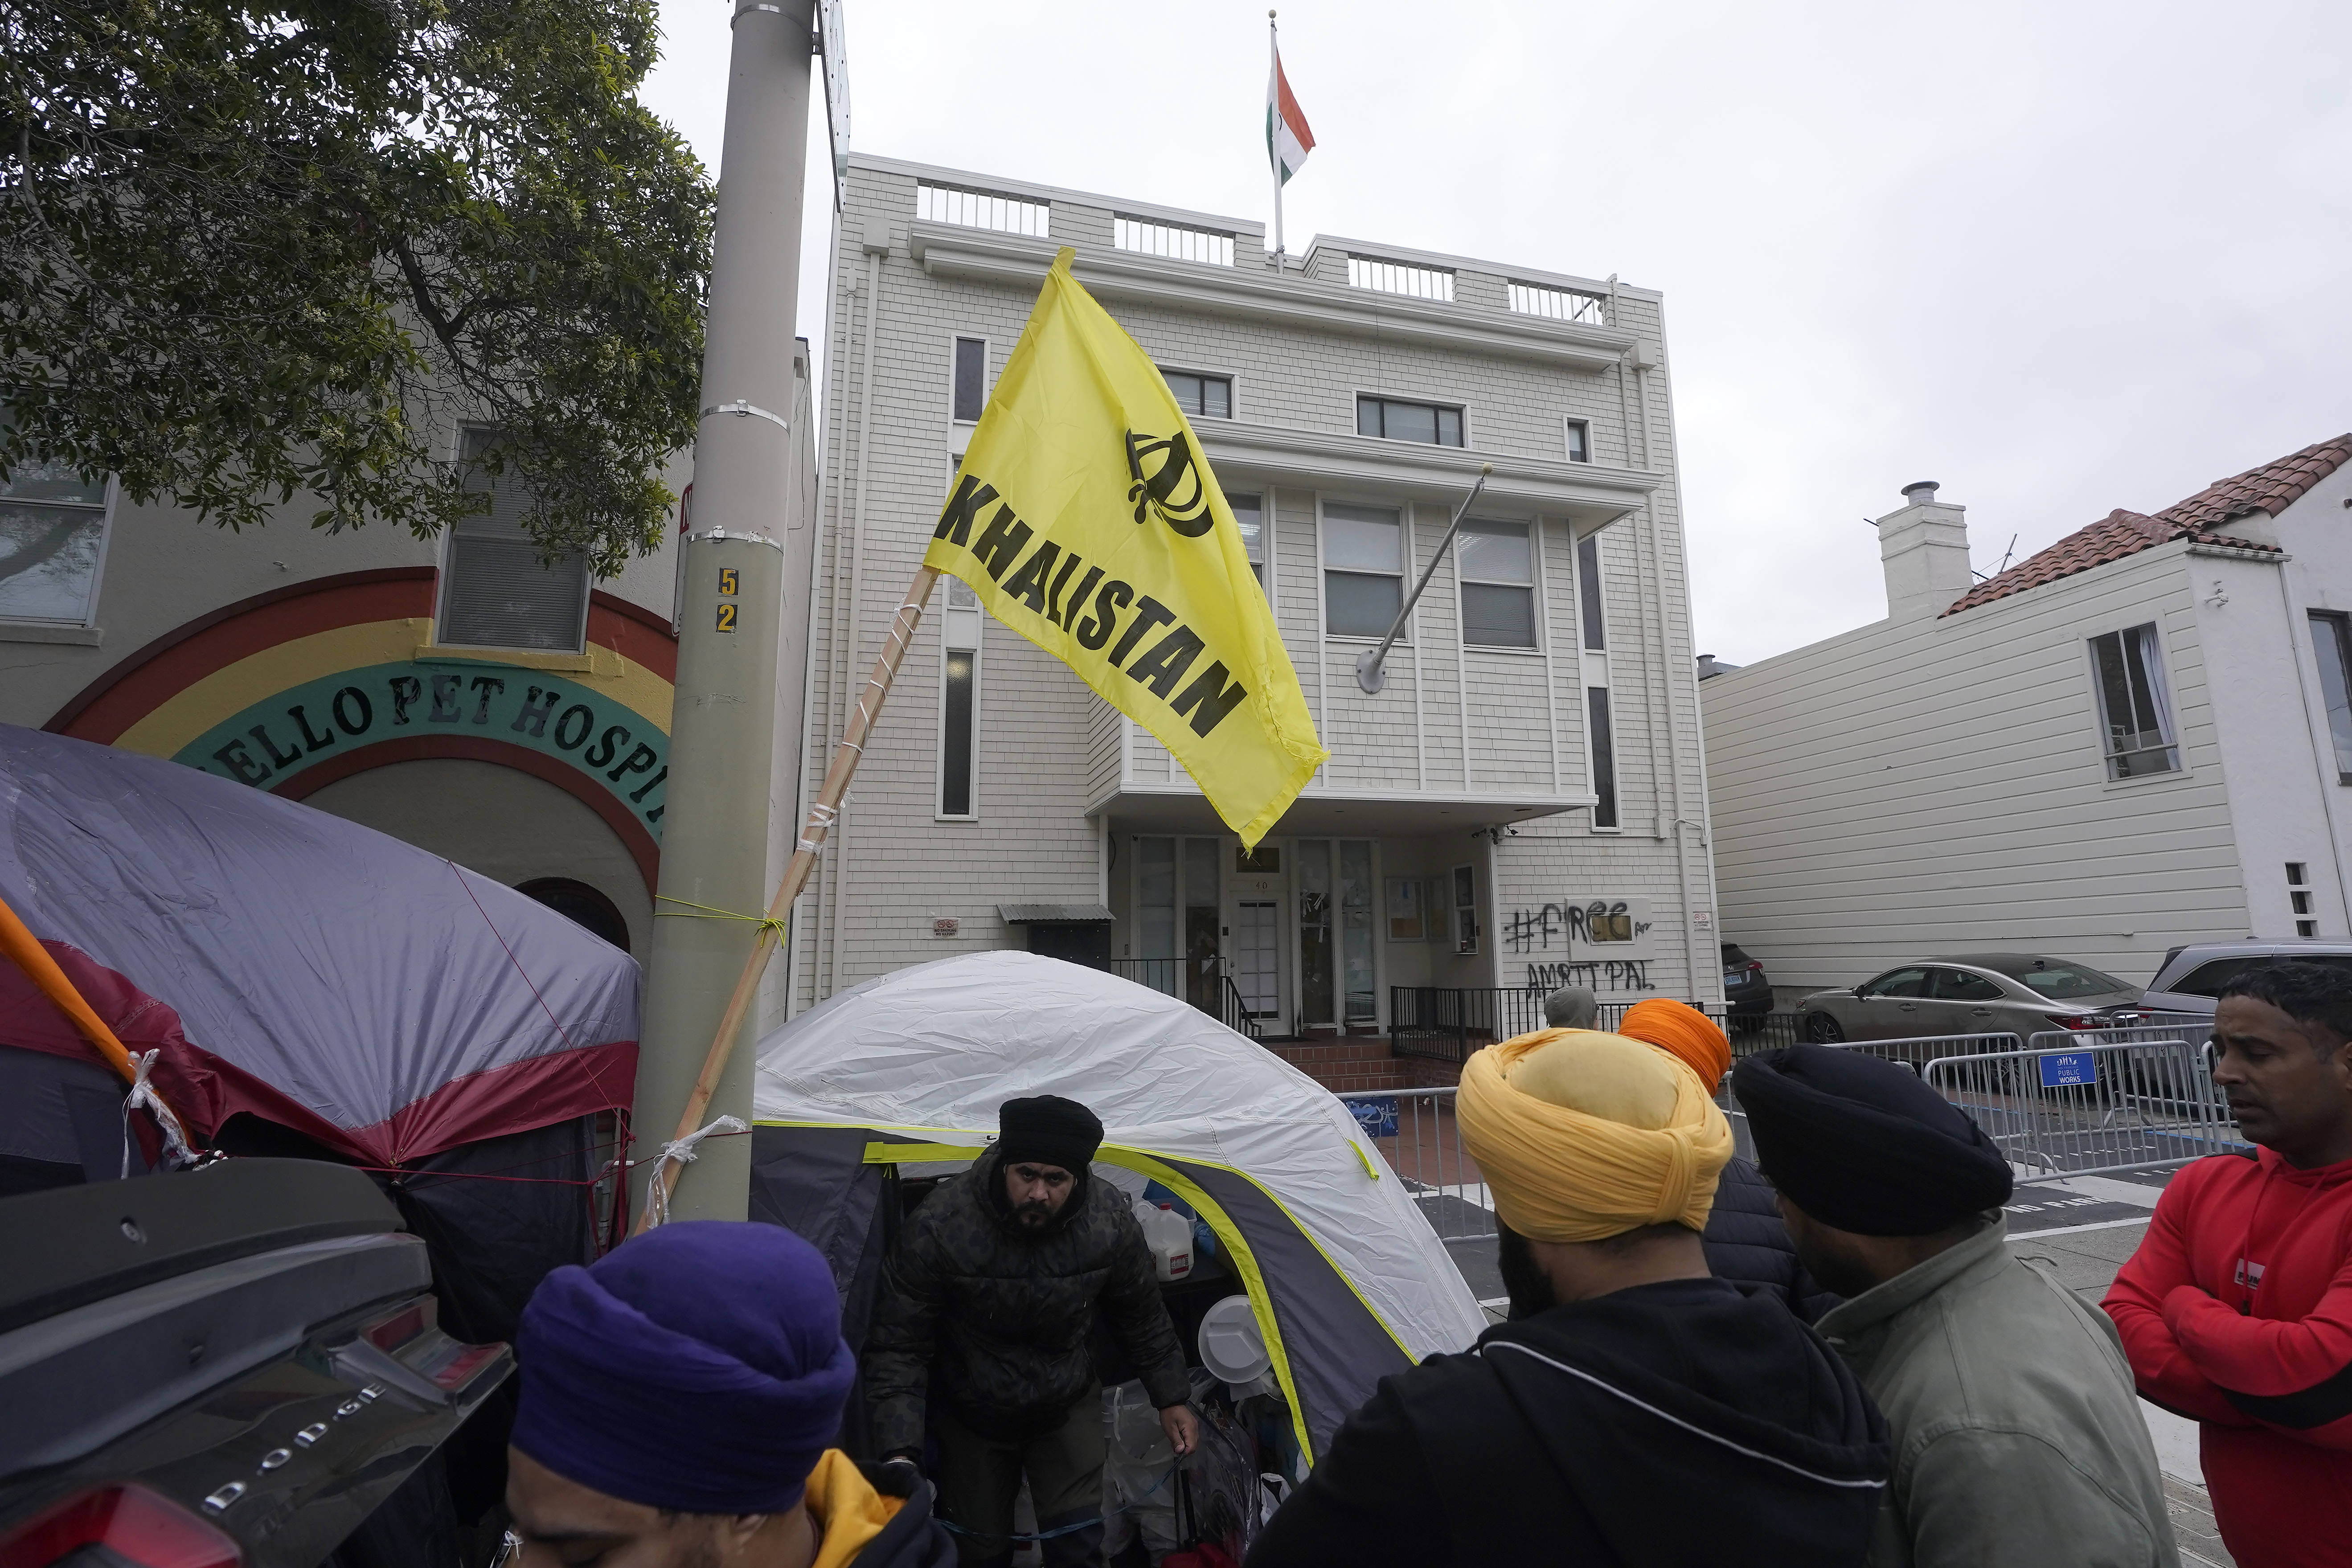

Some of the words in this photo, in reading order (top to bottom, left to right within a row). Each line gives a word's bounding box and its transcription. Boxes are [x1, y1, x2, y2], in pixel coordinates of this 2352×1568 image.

[933, 474, 1248, 738] KHALISTAN
[197, 686, 373, 787] ELLO
[389, 674, 505, 725] PET
[511, 685, 668, 823] HOSPI
[2059, 1075, 2081, 1084] WORKS
[203, 1383, 387, 1511] DODGE
